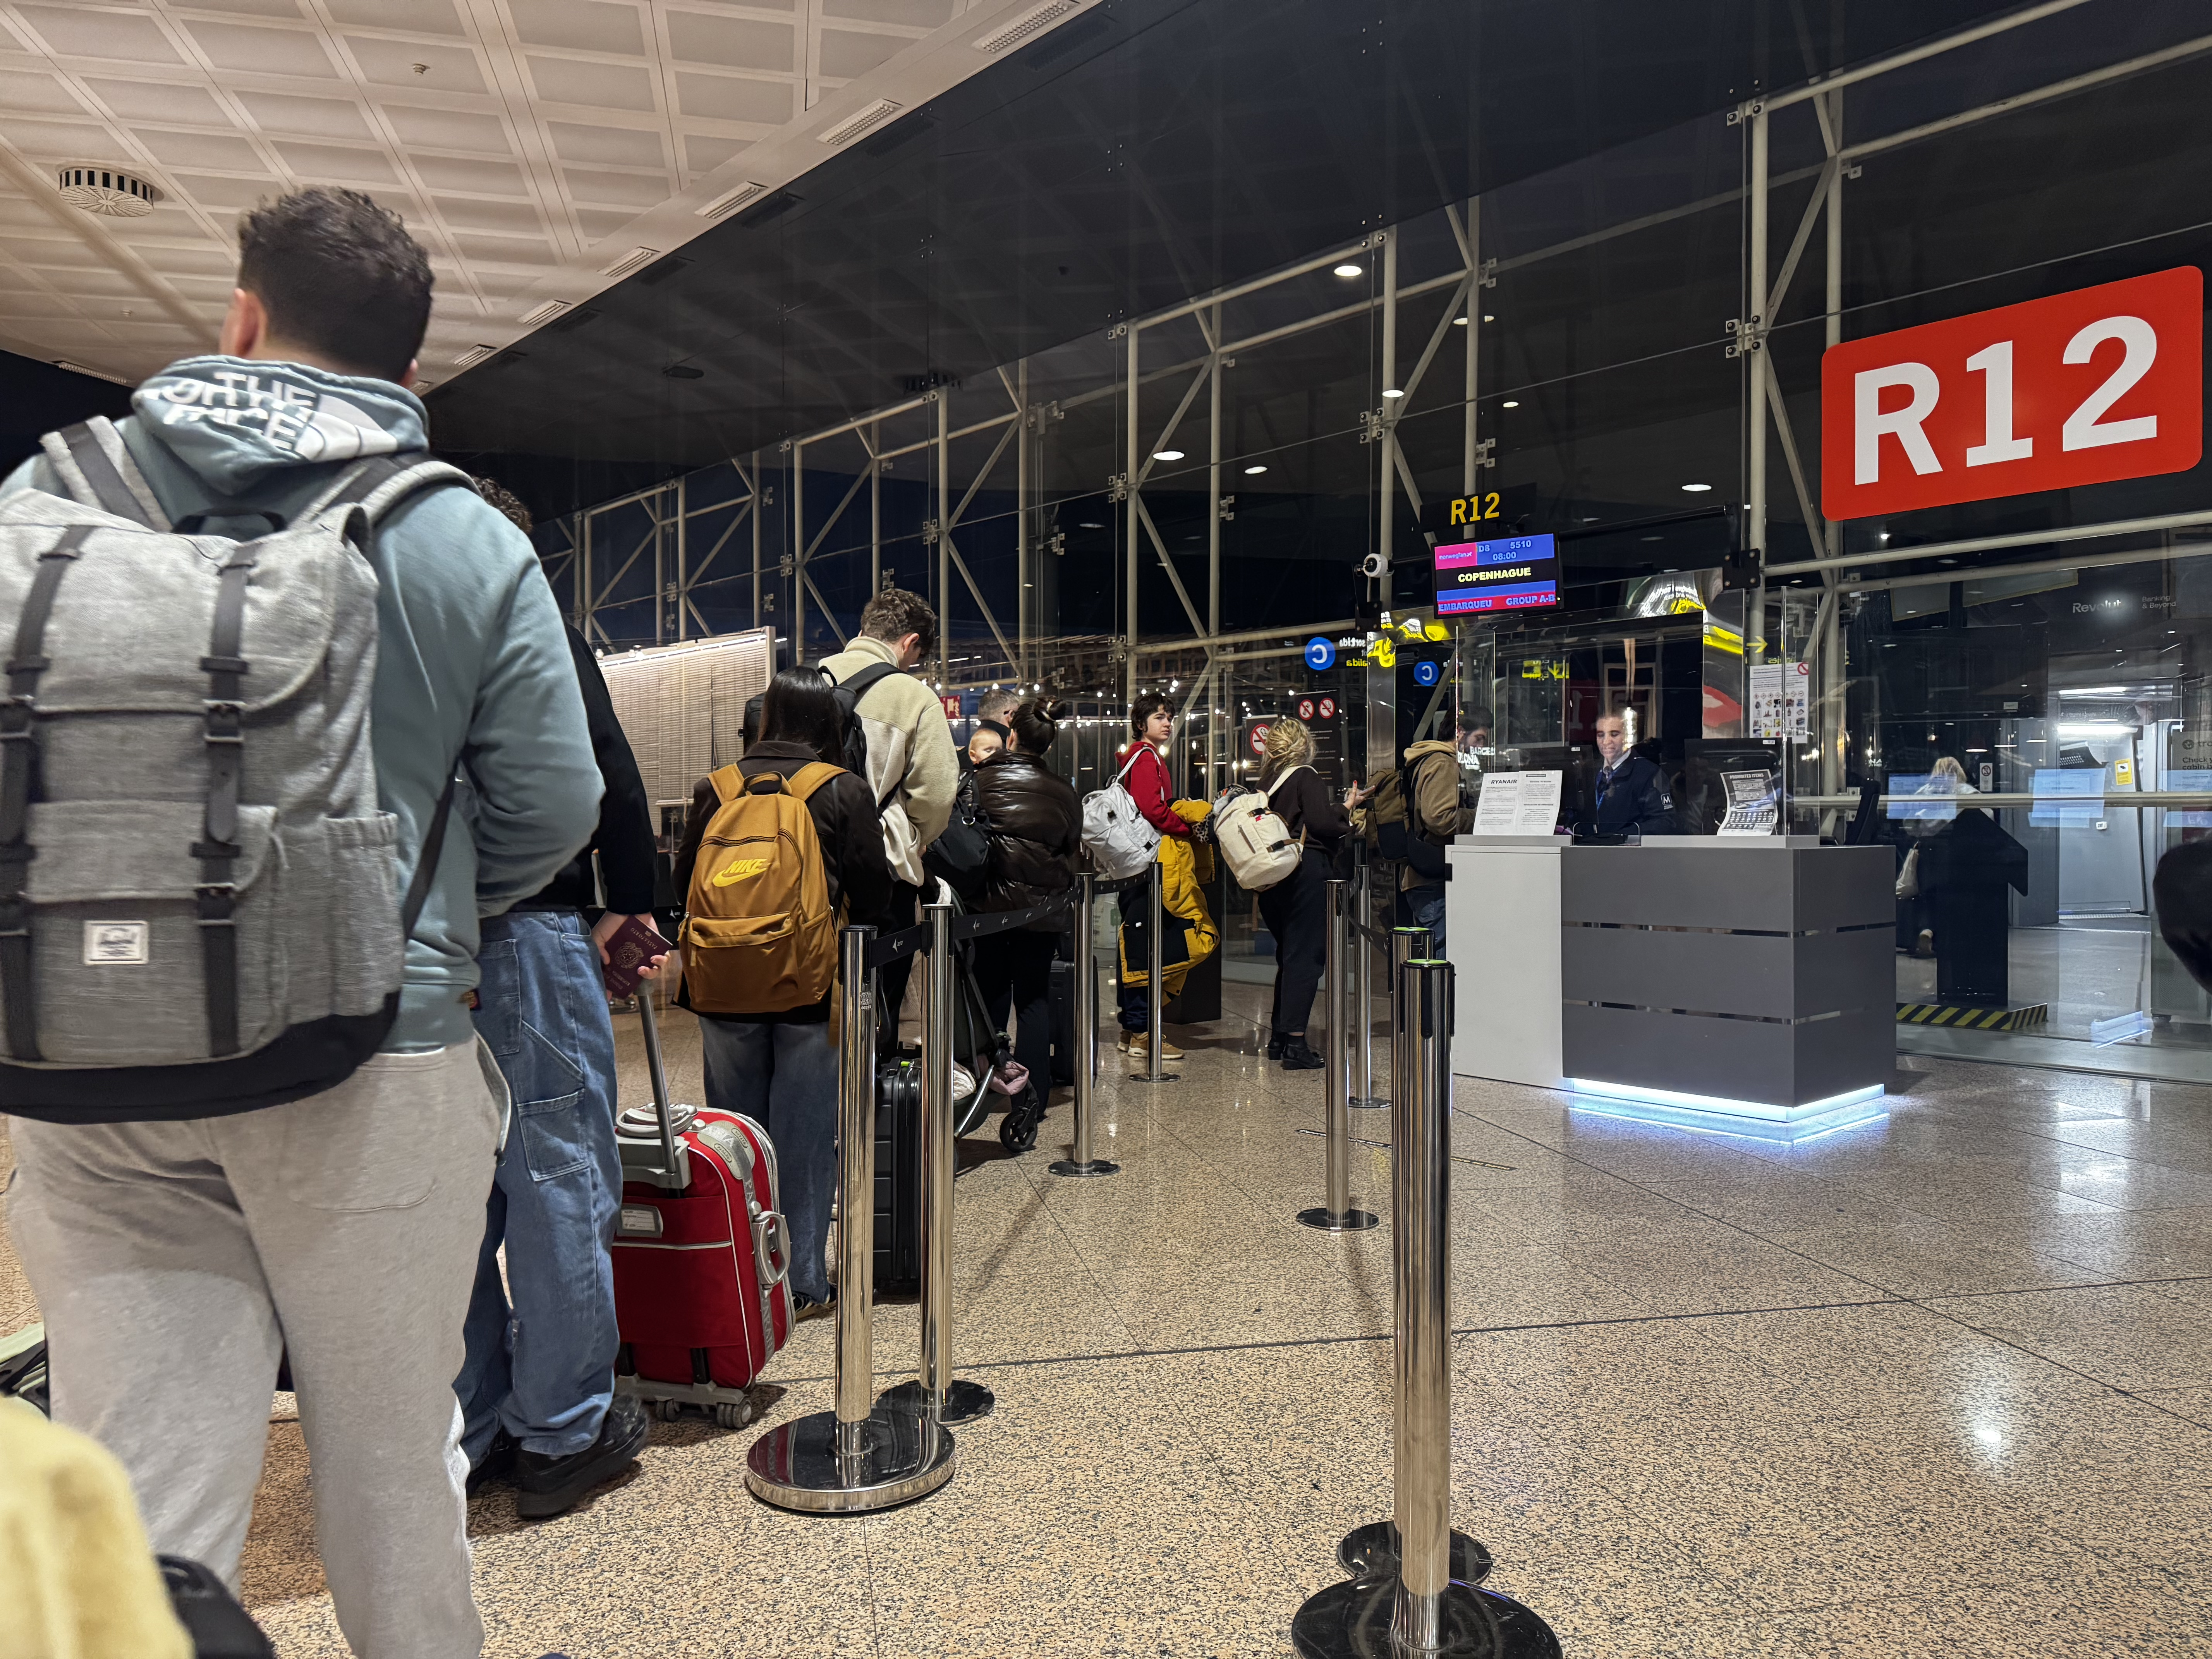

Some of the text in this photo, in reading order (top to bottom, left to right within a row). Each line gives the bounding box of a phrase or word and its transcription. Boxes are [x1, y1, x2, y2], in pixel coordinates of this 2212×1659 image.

[214, 371, 317, 407] THE
[1855, 316, 2157, 485] R12
[1451, 492, 1499, 525] R12
[1479, 540, 1532, 553] D8 5510
[1492, 551, 1517, 561] 08:00
[1458, 567, 1531, 582] COPENHAGUE
[1438, 599, 1492, 611] EMBARQUEU
[1506, 596, 1537, 606] GROUP
[2073, 599, 2121, 613] Revolut
[1663, 795, 1671, 804] M
[724, 859, 768, 874] NIKE
[630, 927, 658, 950] PASSAPORTO
